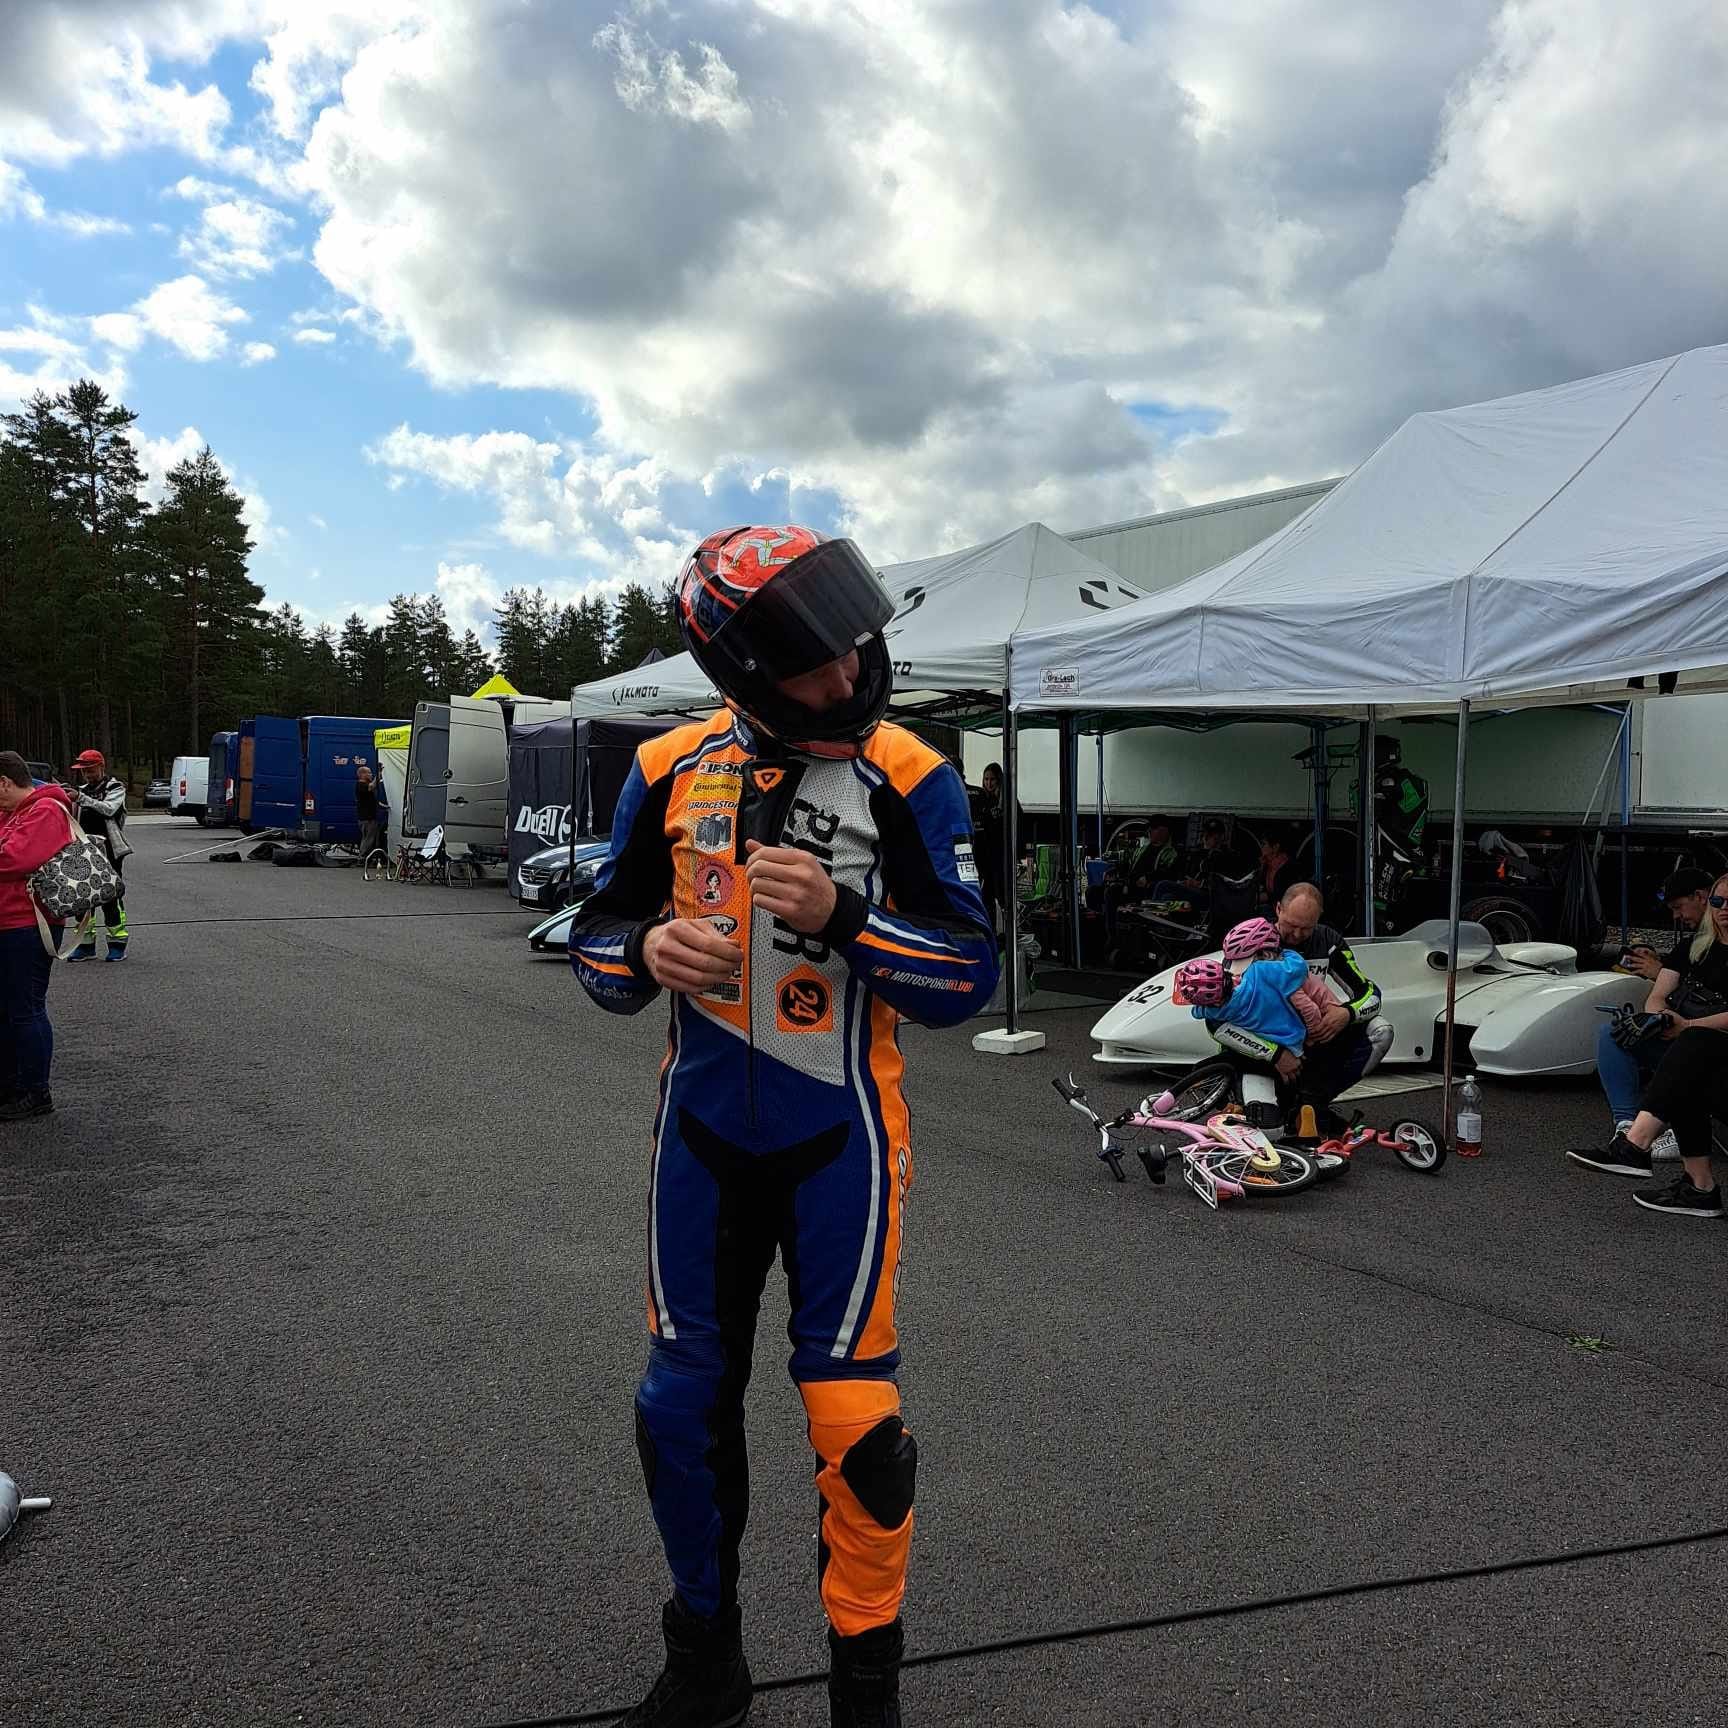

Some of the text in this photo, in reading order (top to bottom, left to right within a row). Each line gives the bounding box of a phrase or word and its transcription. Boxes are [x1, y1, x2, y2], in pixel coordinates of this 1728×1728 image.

[708, 763, 742, 775] IPON
[688, 801, 738, 810] BRIDGESTO
[514, 805, 558, 836] Duell
[789, 984, 818, 1022] 24
[1127, 985, 1165, 1004] 32
